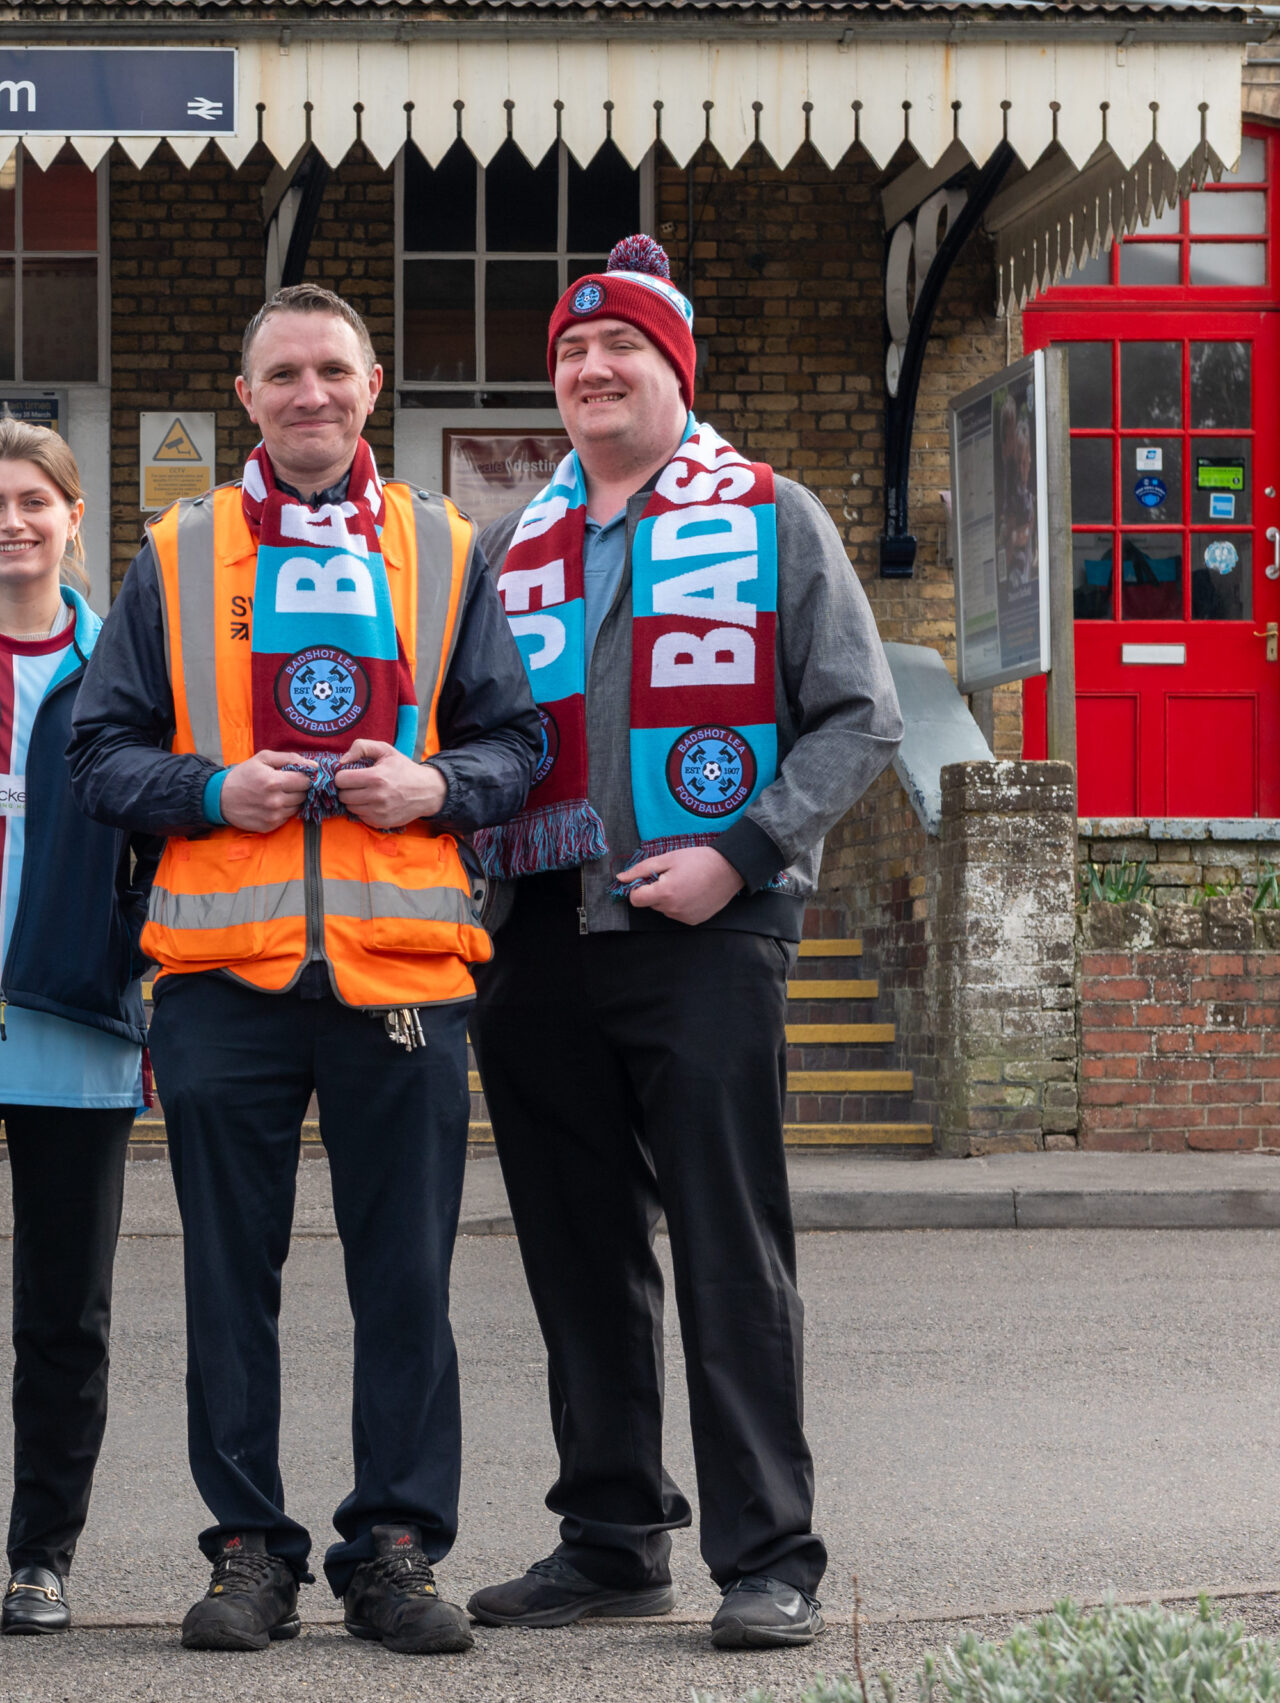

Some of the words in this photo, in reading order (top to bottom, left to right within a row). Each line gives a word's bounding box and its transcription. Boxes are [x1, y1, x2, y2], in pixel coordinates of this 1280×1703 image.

[513, 459, 560, 472] destin
[285, 649, 337, 675] BADSHOT
[337, 654, 358, 674] LEA
[335, 686, 352, 694] 1907
[284, 706, 338, 732] FOOTBALL
[337, 704, 362, 727] CLUB
[677, 729, 726, 753] BADSHOT
[727, 734, 746, 754] LEA
[535, 756, 554, 781] CLUB
[684, 766, 700, 774] EST
[724, 767, 740, 775] 1907
[675, 785, 725, 813] FOOTBALL
[724, 786, 748, 809] CLUB
